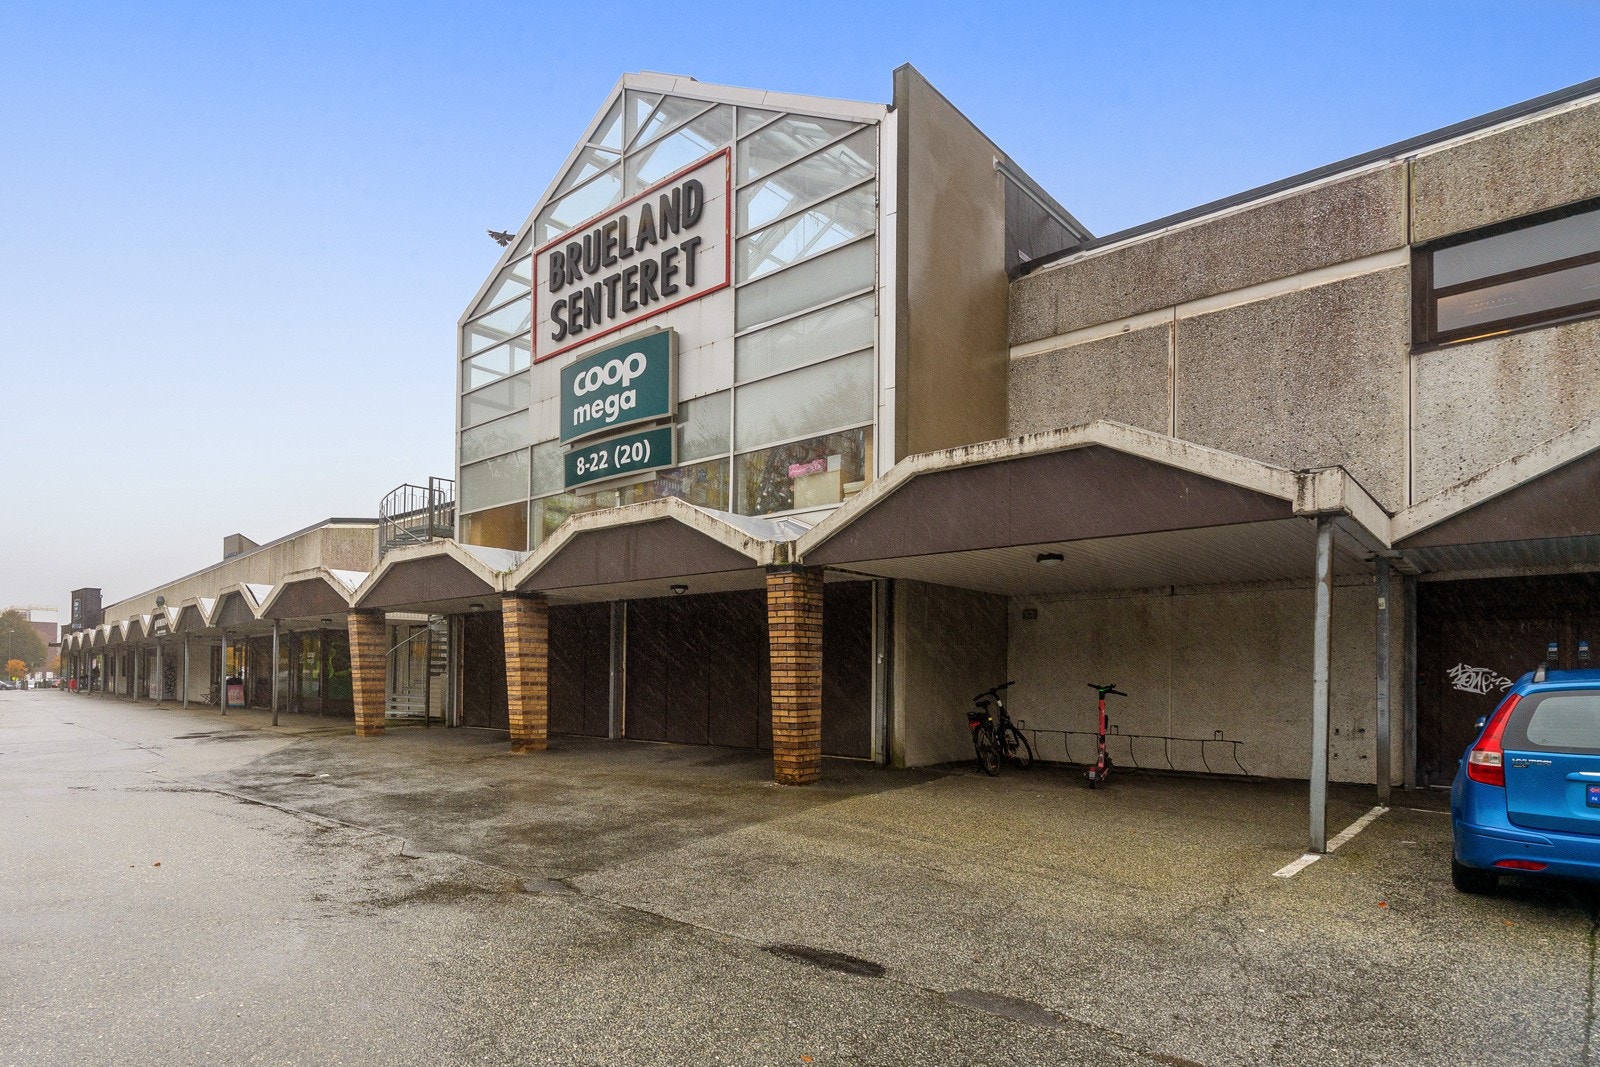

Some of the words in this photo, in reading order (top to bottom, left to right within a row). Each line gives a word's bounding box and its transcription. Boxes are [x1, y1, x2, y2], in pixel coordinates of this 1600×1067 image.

[549, 178, 704, 294] BRUELAND
[550, 235, 701, 342] SENTERET
[573, 352, 647, 397] coop
[573, 388, 636, 426] mega
[576, 450, 608, 476] 8-22
[614, 439, 651, 469] (20)
